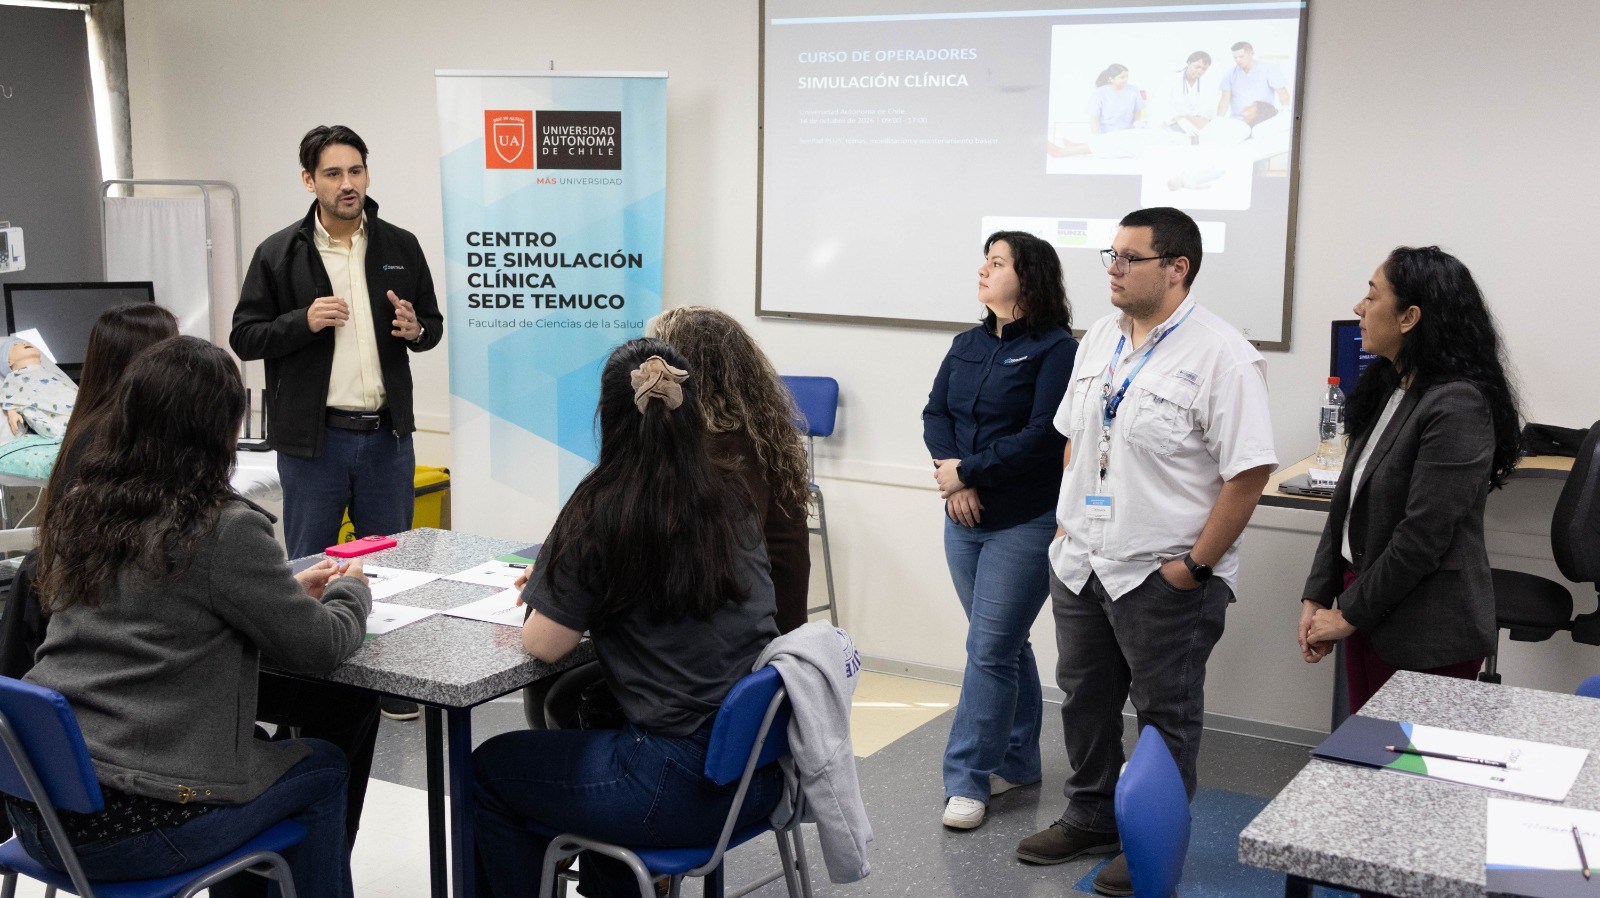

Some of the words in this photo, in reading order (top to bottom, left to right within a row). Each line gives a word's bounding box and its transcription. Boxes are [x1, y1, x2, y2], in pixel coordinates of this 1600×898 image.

[798, 51, 847, 63] CURSO
[852, 51, 870, 62] DE
[875, 48, 977, 62] OPERADORES
[798, 73, 899, 89] SIMULACIÓN
[904, 71, 968, 88] CLÍNICA
[542, 126, 615, 136] UNIVERSIDAD
[499, 135, 520, 147] UA
[542, 136, 615, 146] AUTONOMA
[569, 148, 614, 156] CHILE
[536, 176, 557, 185] MÁS
[559, 178, 623, 186] UNIVERSIDAD
[466, 231, 557, 248] CENTRO
[467, 252, 497, 268] DE
[504, 249, 643, 269] SIMULACIÓN
[467, 269, 556, 289] CLÍNICA
[468, 293, 525, 309] SEDE
[531, 293, 625, 310] TEMUCO
[468, 318, 516, 328] Facultad
[518, 318, 533, 328] de
[535, 318, 582, 329] Ciencias
[584, 318, 599, 329] de
[601, 318, 611, 329] la
[613, 319, 644, 329] Salud
